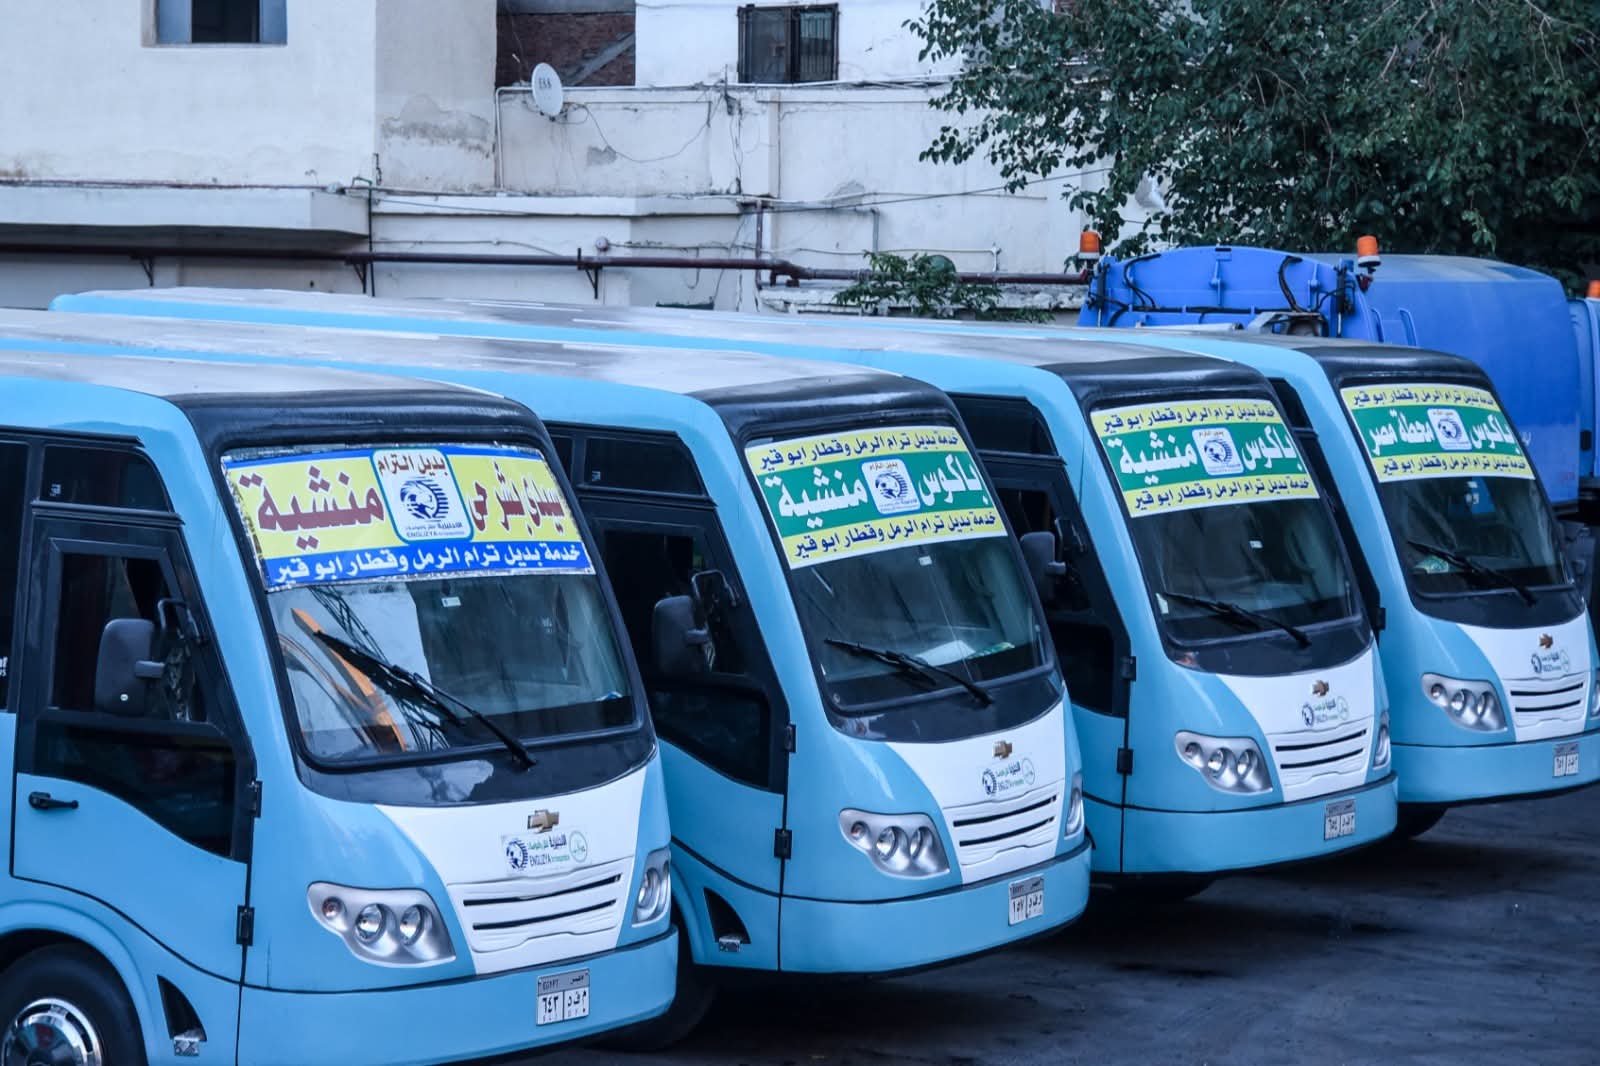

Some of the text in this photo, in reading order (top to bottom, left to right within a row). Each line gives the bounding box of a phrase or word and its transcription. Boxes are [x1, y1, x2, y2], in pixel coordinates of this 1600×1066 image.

[1388, 407, 1435, 444] محطة
[1469, 413, 1521, 455] باكوس
[811, 440, 852, 461] وقطار
[853, 435, 885, 455] الرمل
[887, 432, 911, 450] ترام
[914, 433, 939, 450] بديل
[1368, 423, 1399, 457] مصر
[377, 453, 449, 477] بديل الترام
[760, 448, 785, 471] قير
[786, 447, 807, 466] ابو
[1106, 424, 1303, 486] باكوس منشية
[763, 453, 990, 529] باكوس منشية
[238, 465, 386, 551] منشية
[887, 519, 919, 540] الرمل
[921, 514, 945, 534] ترام
[947, 515, 974, 532] بديل
[795, 534, 818, 559] قير
[820, 532, 841, 552] ابو
[844, 523, 885, 548] وقطار
[274, 542, 581, 589] خدمة بديل ترام الرمل وقطار ابو قير
